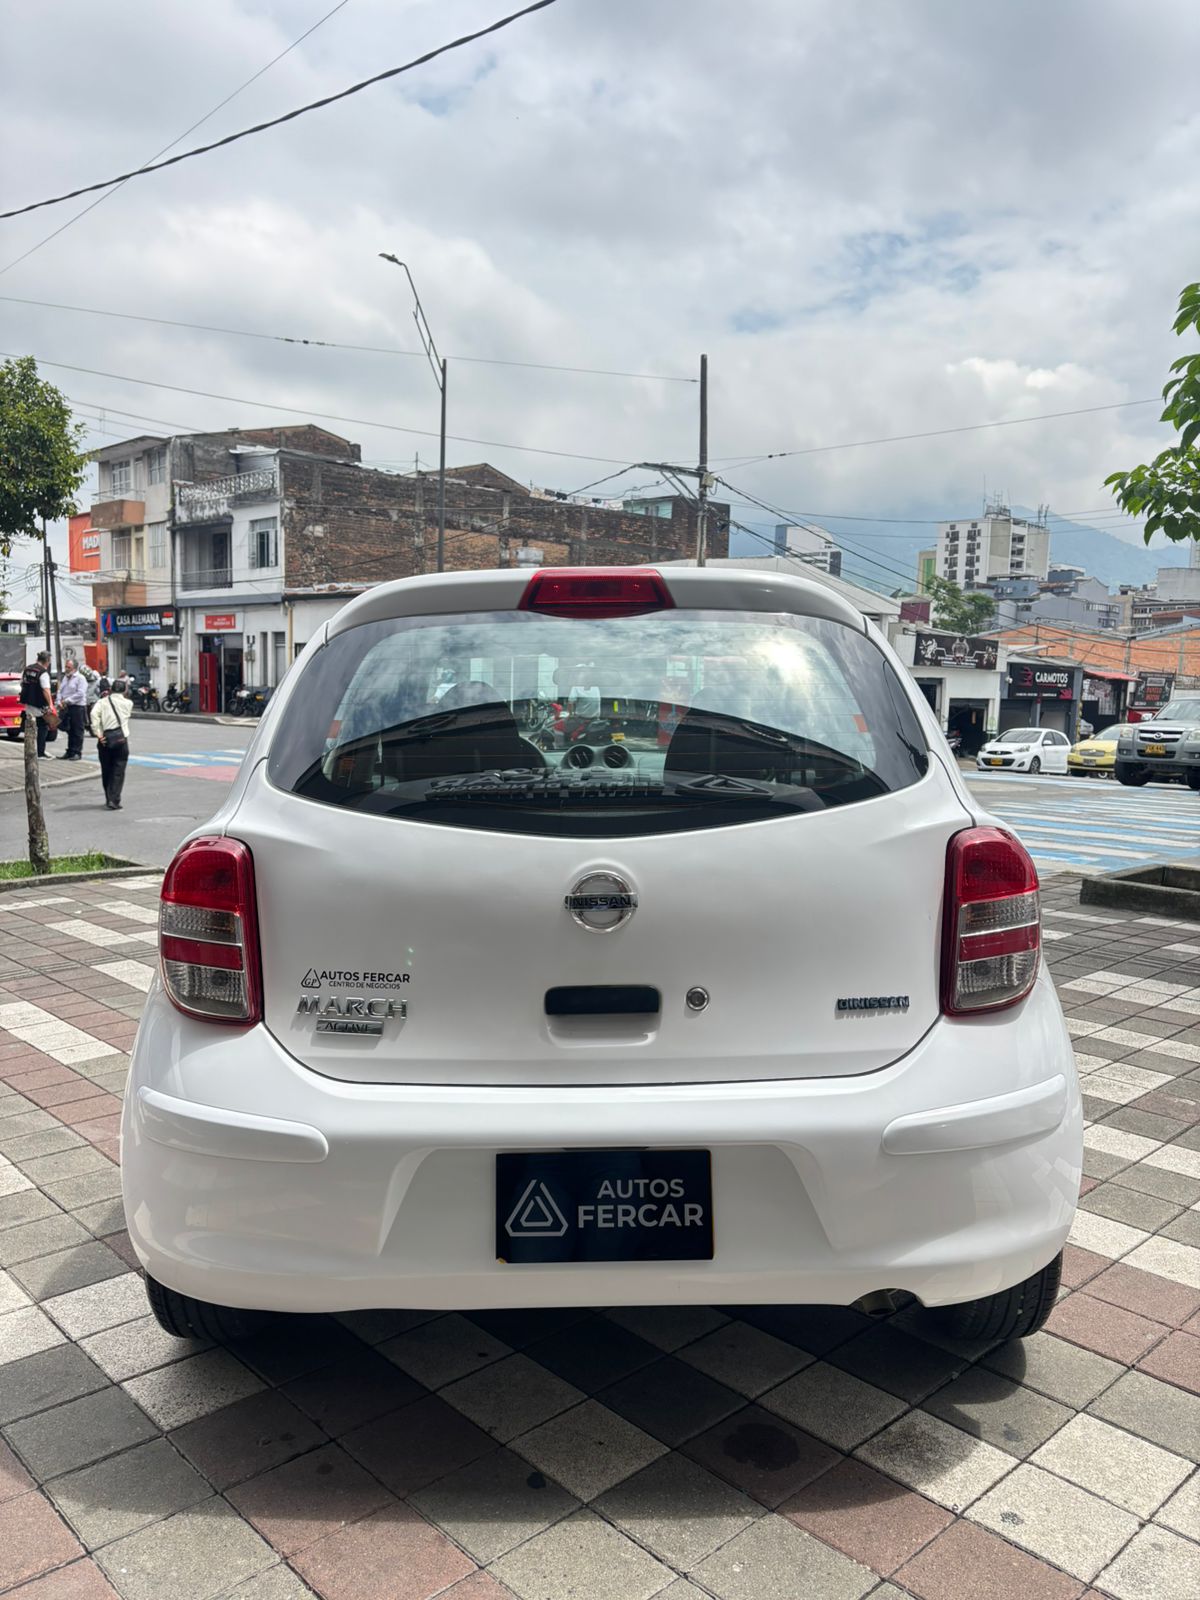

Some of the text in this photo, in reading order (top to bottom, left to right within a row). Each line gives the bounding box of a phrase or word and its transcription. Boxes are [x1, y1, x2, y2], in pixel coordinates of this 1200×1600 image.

[116, 614, 131, 626] CASA
[132, 612, 160, 625] ALEMANA
[1035, 671, 1068, 684] CARMOTOS
[570, 895, 631, 906] NISSAN
[320, 970, 360, 981] AUTOS
[363, 972, 410, 983] FERCAR
[366, 982, 400, 990] NEGOCIOS
[296, 995, 408, 1019] MARCH
[324, 1022, 373, 1033] ACTIVE
[597, 1179, 685, 1199] AUTOS
[577, 1203, 703, 1228] FERCAR
